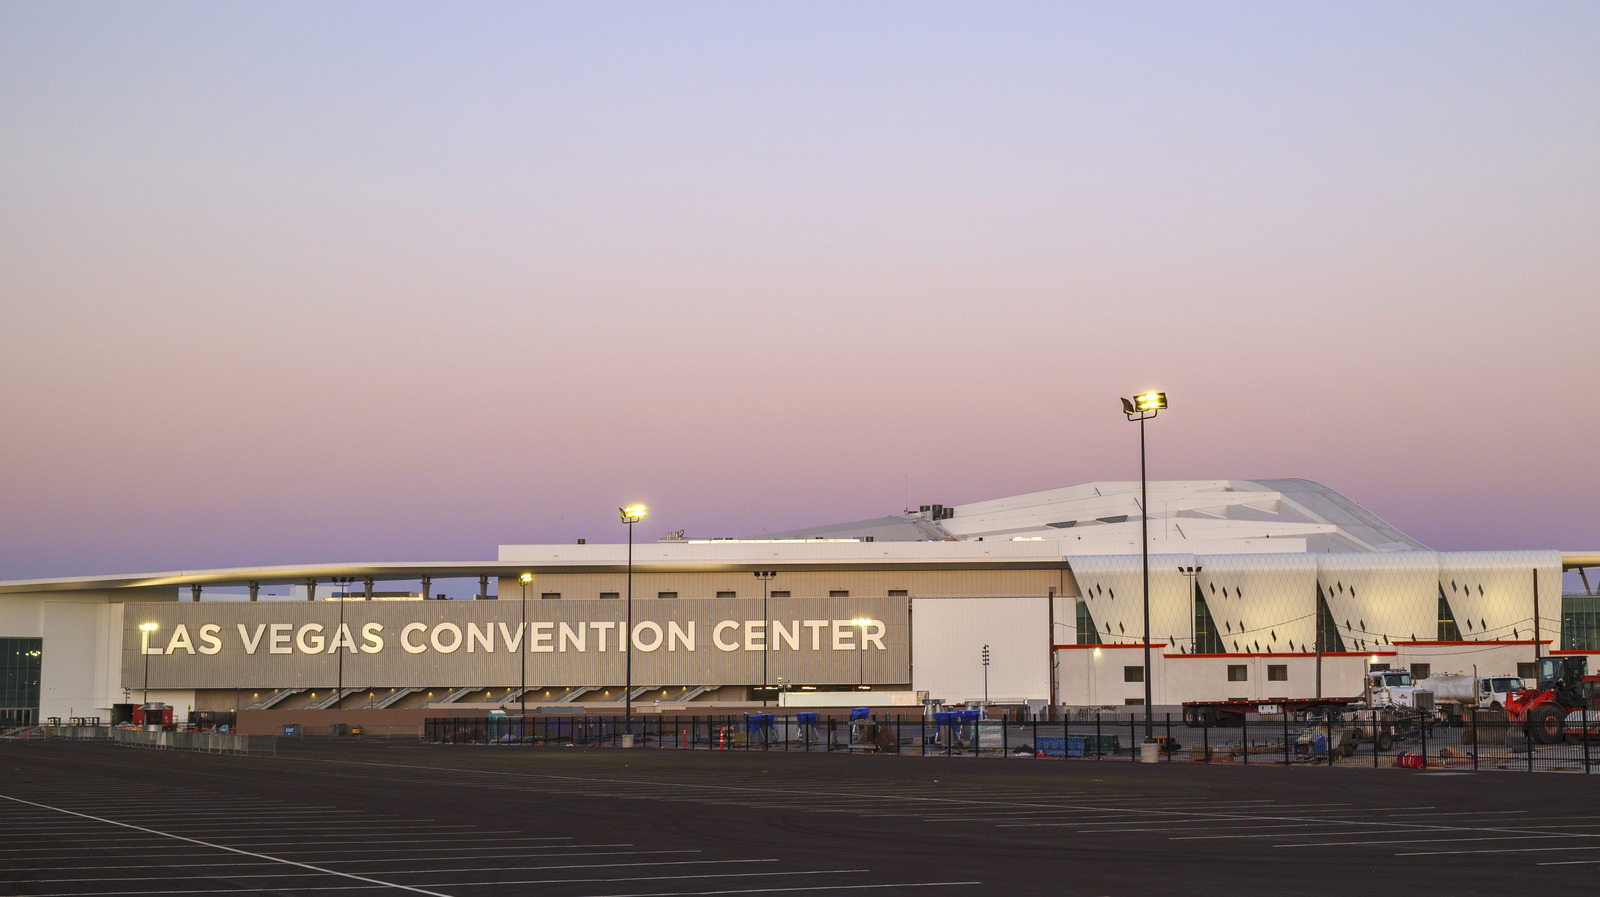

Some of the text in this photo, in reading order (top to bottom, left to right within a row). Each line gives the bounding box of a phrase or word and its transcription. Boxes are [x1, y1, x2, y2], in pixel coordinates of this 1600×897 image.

[141, 619, 887, 655] LAS VEGAS CONVENTION CENTER
